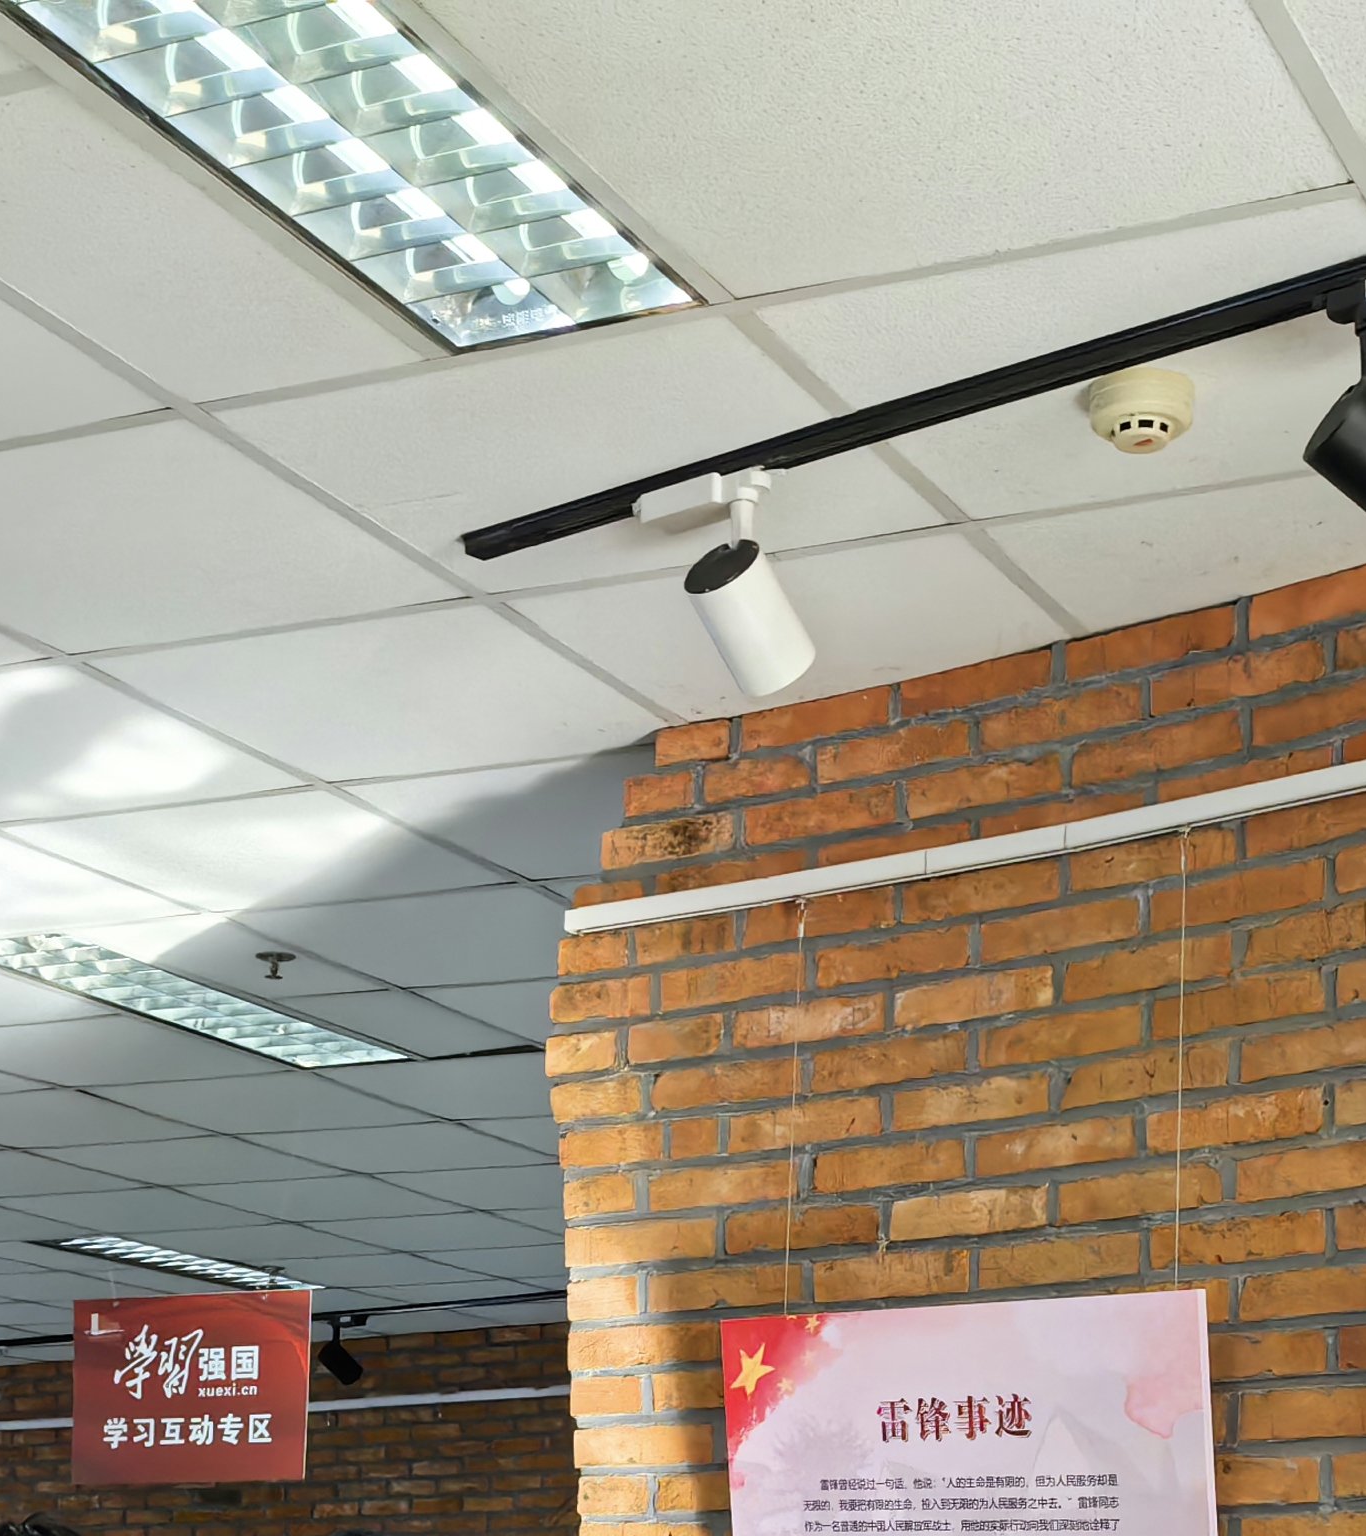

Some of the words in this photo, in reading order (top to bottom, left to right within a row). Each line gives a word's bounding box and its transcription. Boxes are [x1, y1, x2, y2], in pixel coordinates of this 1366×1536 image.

[198, 1384, 258, 1397] xuexi.cn
[102, 1413, 272, 1449] 学习互动专区
[876, 1393, 1032, 1443] 雷锋事迹
